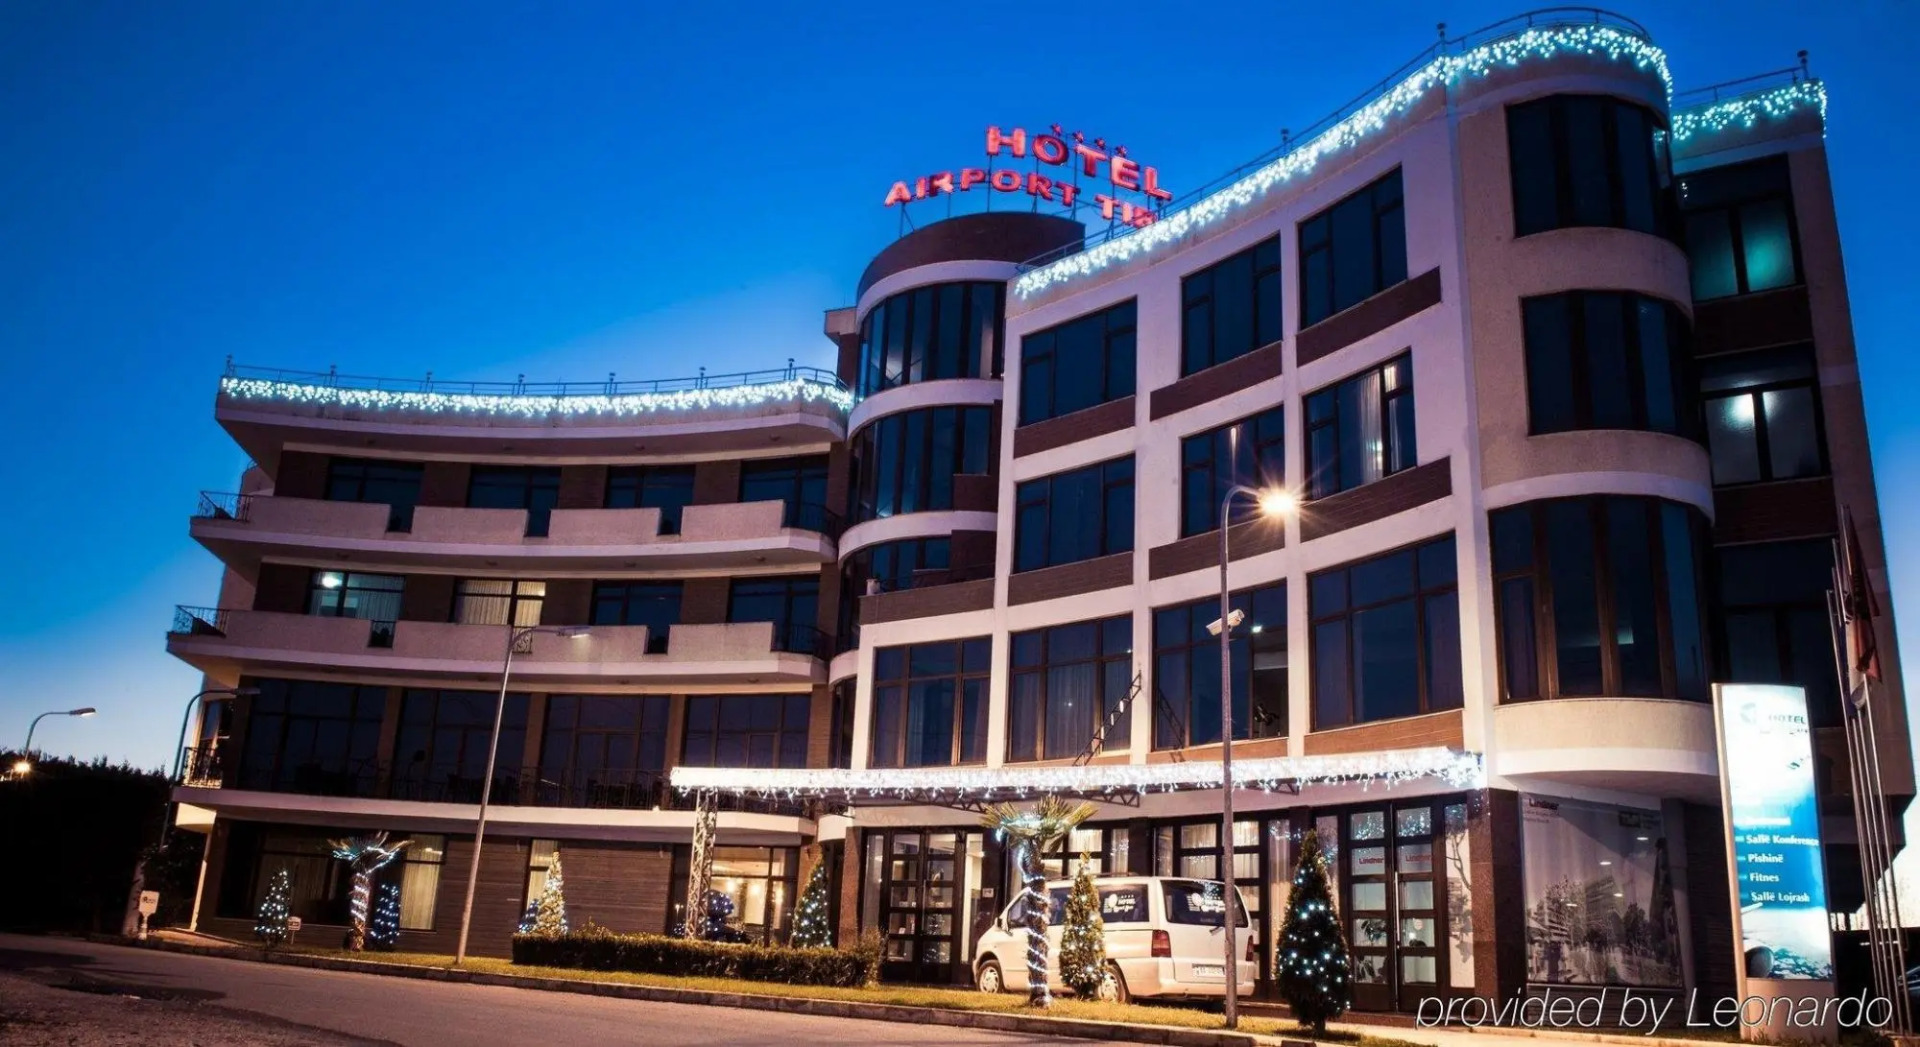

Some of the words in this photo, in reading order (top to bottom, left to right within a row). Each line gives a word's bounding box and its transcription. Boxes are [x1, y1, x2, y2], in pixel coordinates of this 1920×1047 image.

[986, 125, 1173, 202] HOTEL
[884, 168, 1081, 207] AIRPORT
[1748, 853, 1784, 863] Pishinë
[1749, 872, 1780, 882] Fitnes
[1751, 891, 1775, 901] Sallë
